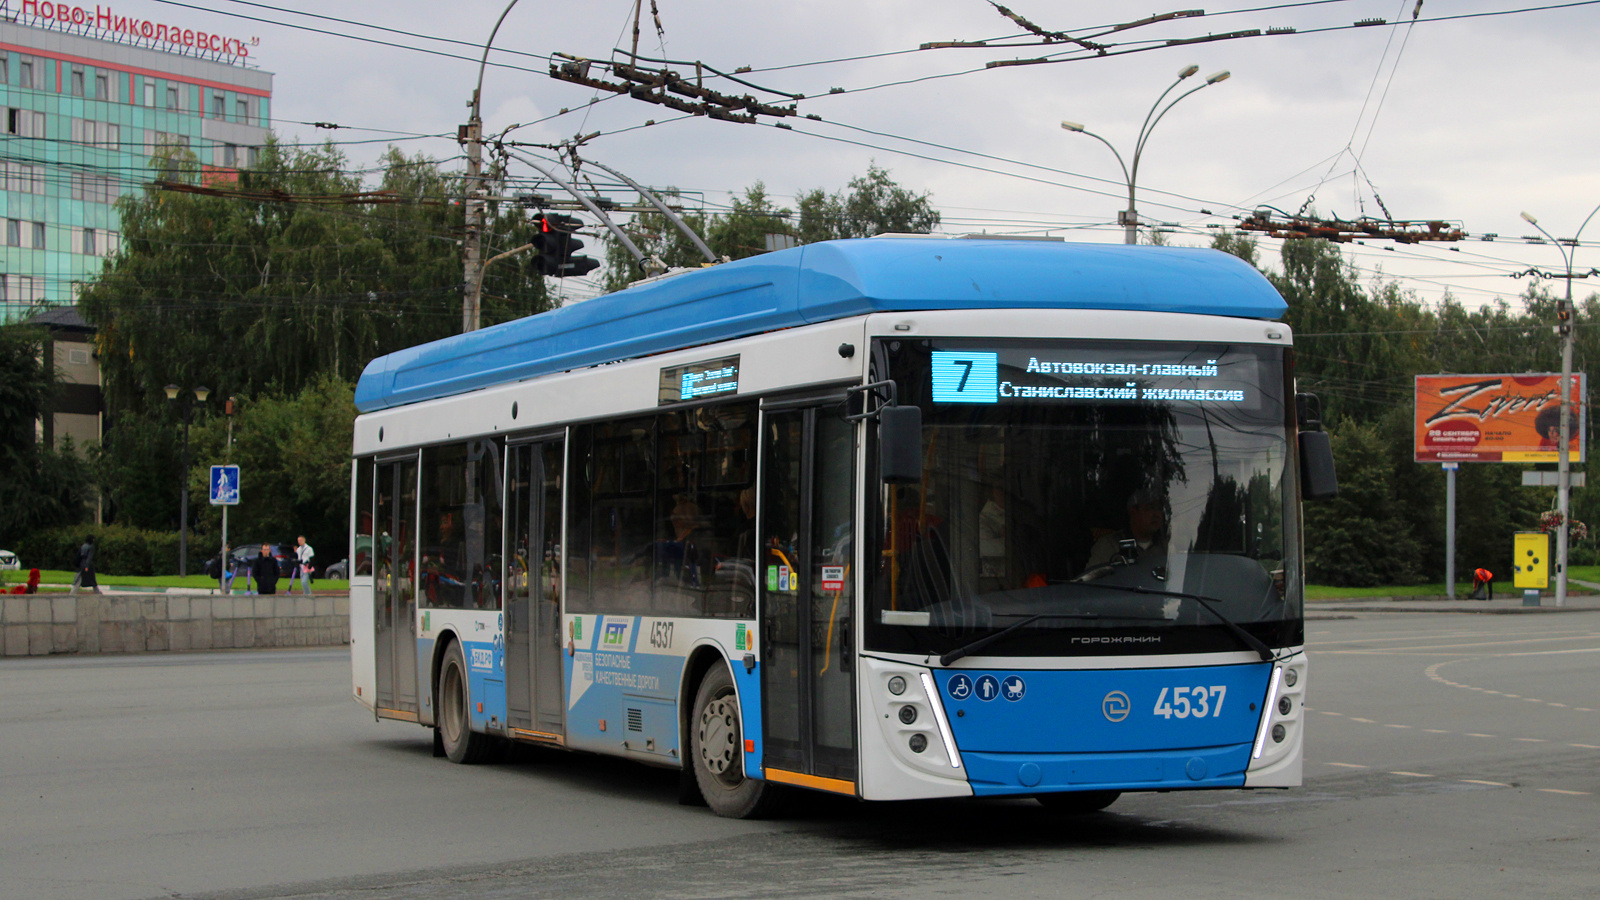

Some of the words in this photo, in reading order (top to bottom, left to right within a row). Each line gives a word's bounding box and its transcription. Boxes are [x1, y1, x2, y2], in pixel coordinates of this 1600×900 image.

[953, 359, 974, 393] 7
[1026, 357, 1218, 378] Автовокзал-главный
[998, 381, 1137, 400] Станиславский
[1141, 386, 1245, 402] жилмассив
[1424, 379, 1560, 428] Zivert
[650, 621, 674, 648] 4537
[1071, 635, 1161, 644] ГОРОЖАНИН
[594, 652, 631, 669] БЕЗОПАСНЫЕ
[594, 671, 637, 688] КАЧЕСТВЕННЫЕ
[637, 674, 660, 690] ДОРОГИ
[1153, 685, 1227, 719] 4537
